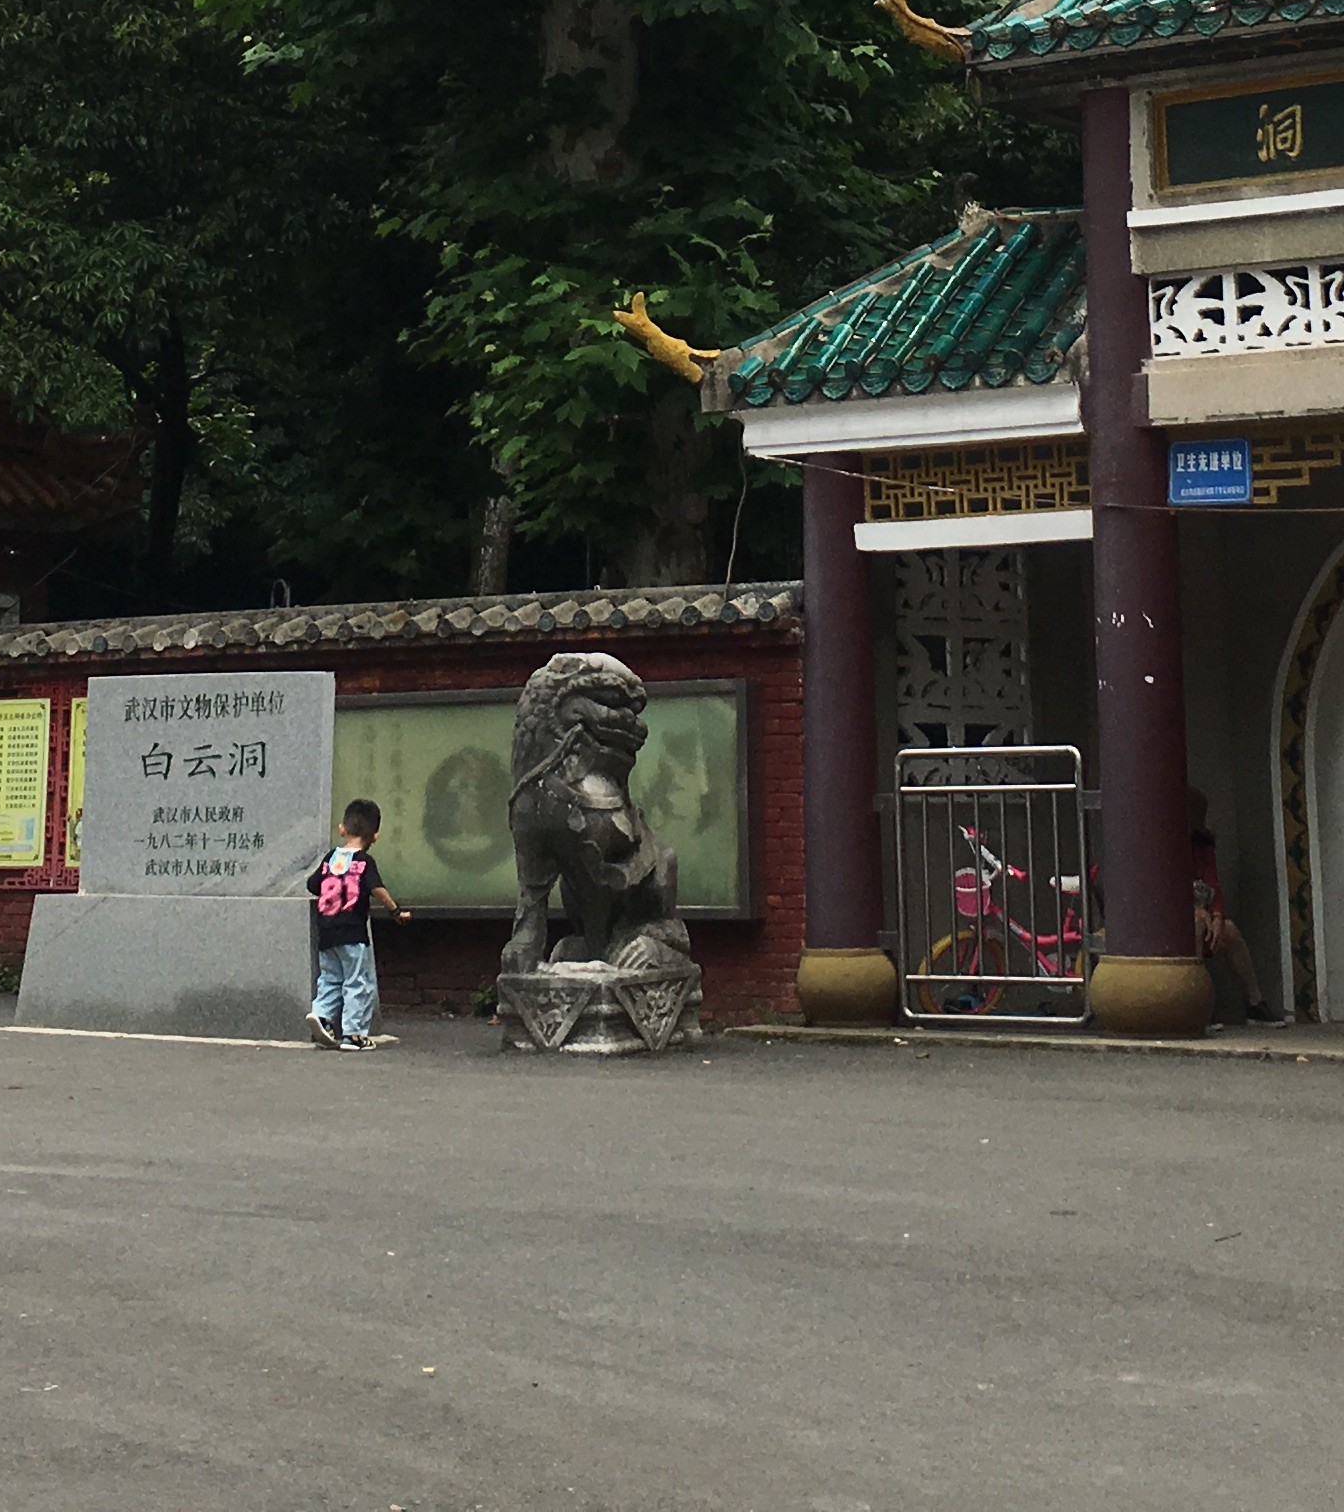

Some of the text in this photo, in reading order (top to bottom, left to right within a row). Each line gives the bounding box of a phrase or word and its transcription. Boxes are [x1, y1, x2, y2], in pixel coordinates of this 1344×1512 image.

[123, 690, 285, 723] 武汉市文物保护单位
[140, 740, 268, 781] 白云洞
[152, 805, 245, 824] 武汉市人民政府
[133, 831, 265, 850] 一九八二年十一月公布
